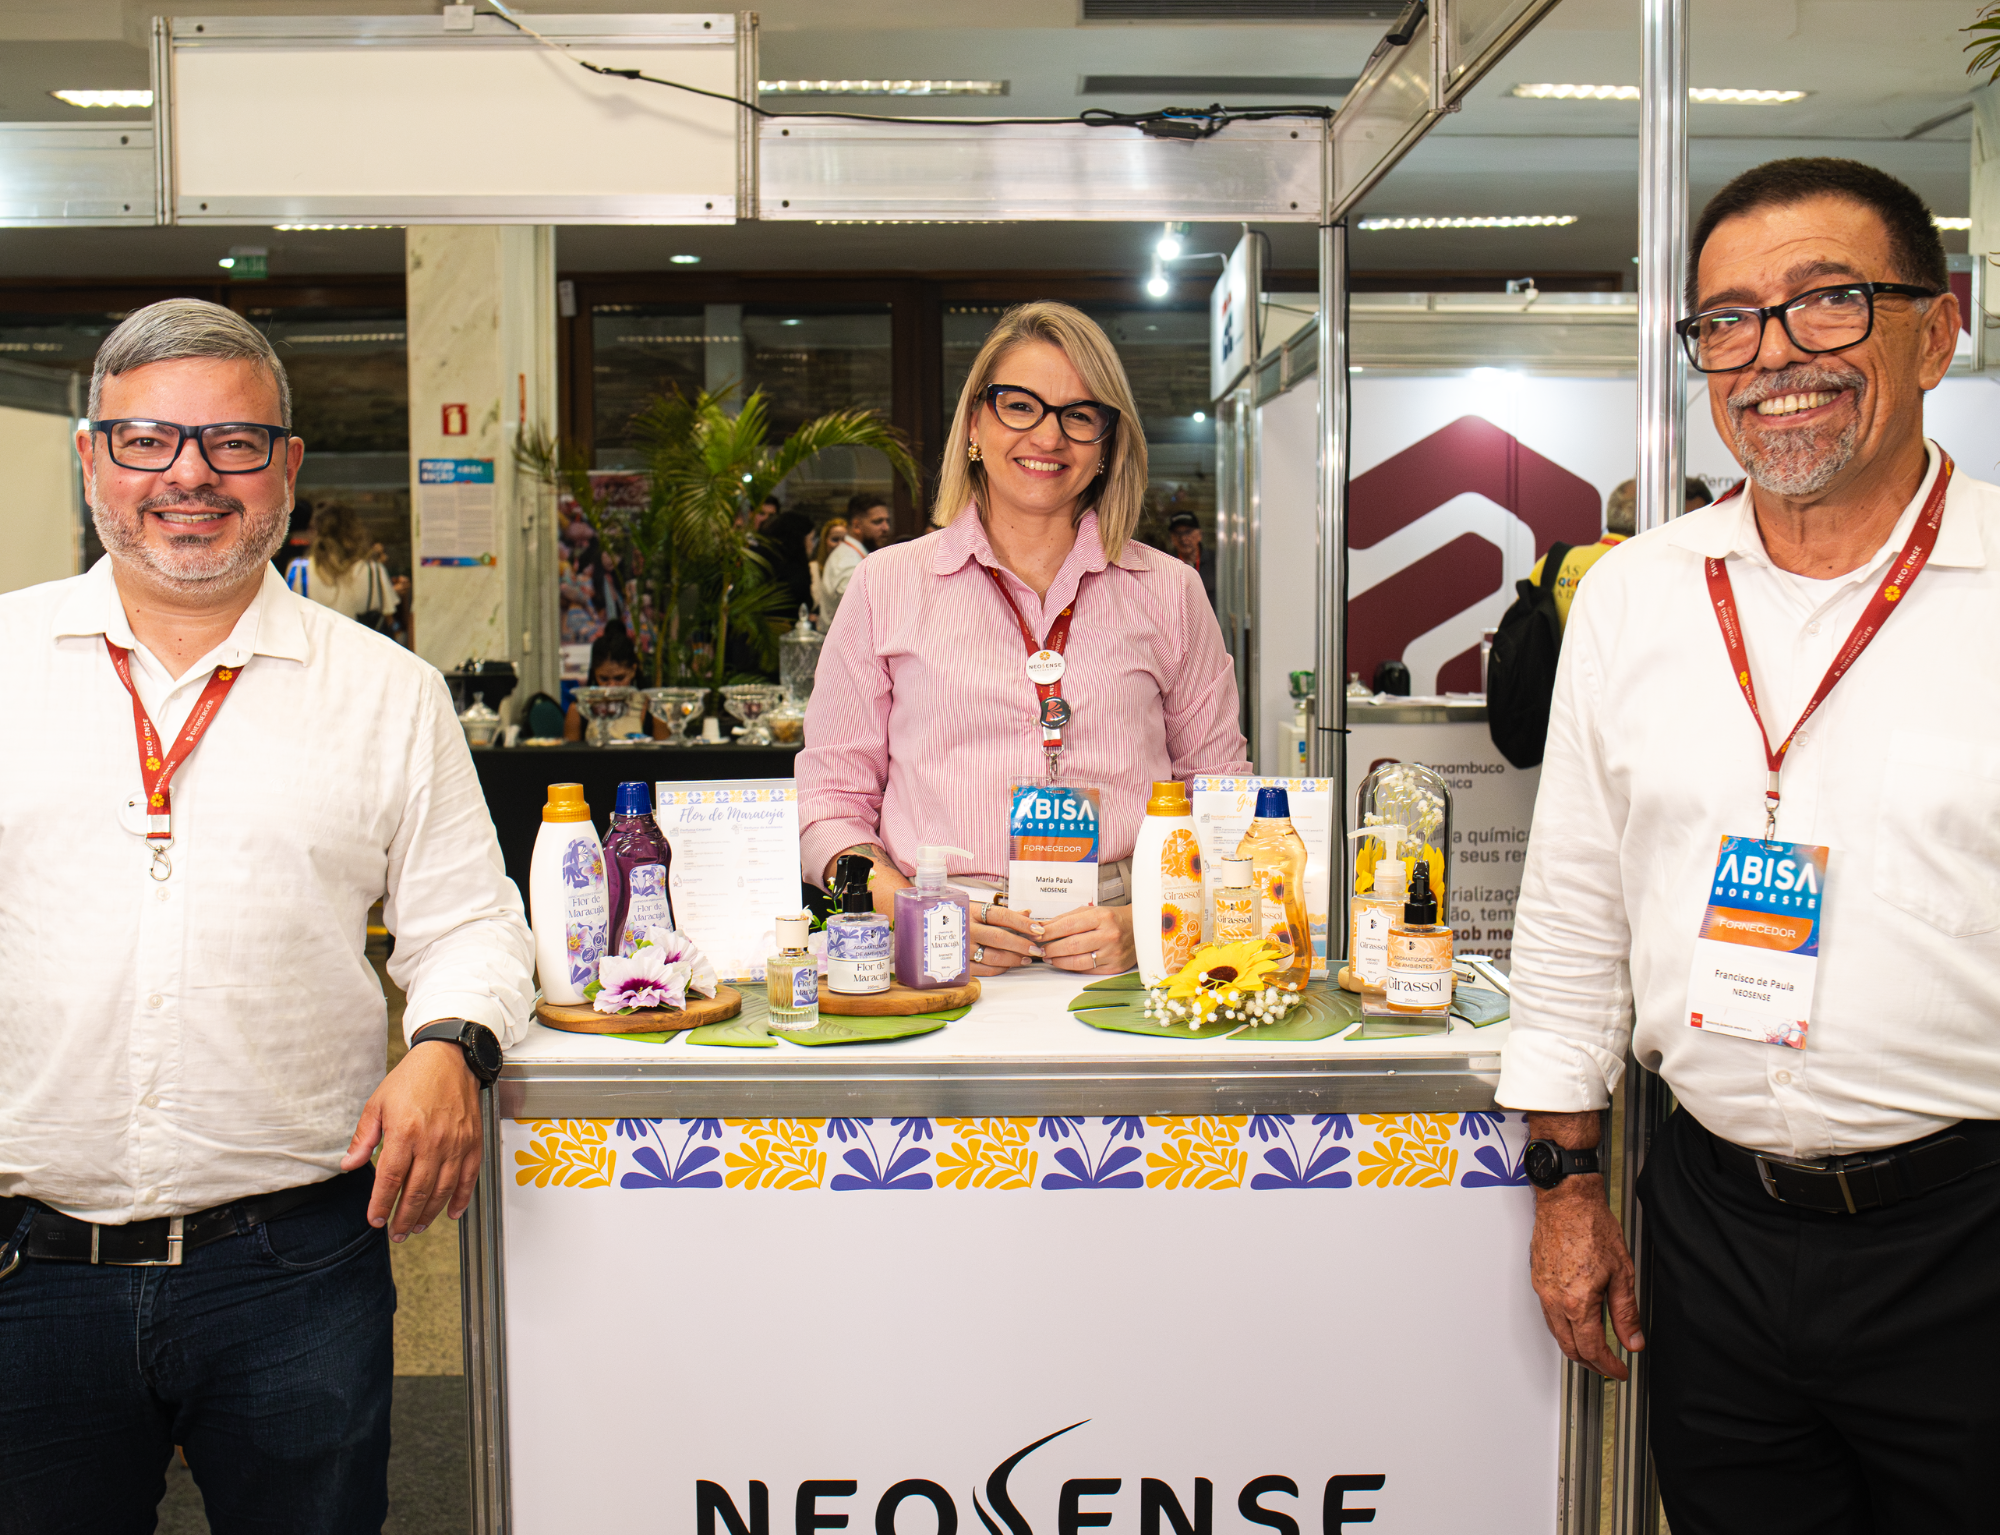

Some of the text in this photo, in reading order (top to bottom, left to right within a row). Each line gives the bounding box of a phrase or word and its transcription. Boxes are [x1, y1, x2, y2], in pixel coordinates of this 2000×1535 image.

[1894, 545, 1922, 586] NEOSENSE
[143, 718, 153, 756] NEOSENSE
[679, 806, 705, 823] Flor
[709, 807, 723, 821] de
[1015, 798, 1095, 821] ABISA
[1014, 822, 1094, 831] NORDESTE
[1468, 827, 1531, 846] químic
[1023, 844, 1082, 853] FORNECEDOR
[1460, 850, 1500, 863] seus
[1718, 854, 1818, 894] ABISA
[573, 895, 601, 907] Flor de
[1164, 889, 1200, 900] Girassol
[1715, 887, 1816, 909] NORDESTE
[1217, 915, 1252, 924] Girassol
[1718, 919, 1796, 938] FORNECEDOR
[857, 963, 875, 971] Flor
[1394, 955, 1434, 963] AROMATIZADOR
[1388, 976, 1442, 992] Girassol
[1715, 969, 1795, 992] Francisco de Paula
[1732, 988, 1771, 1002] NEOSENSE
[695, 1418, 1386, 1535] NEOSENSE
